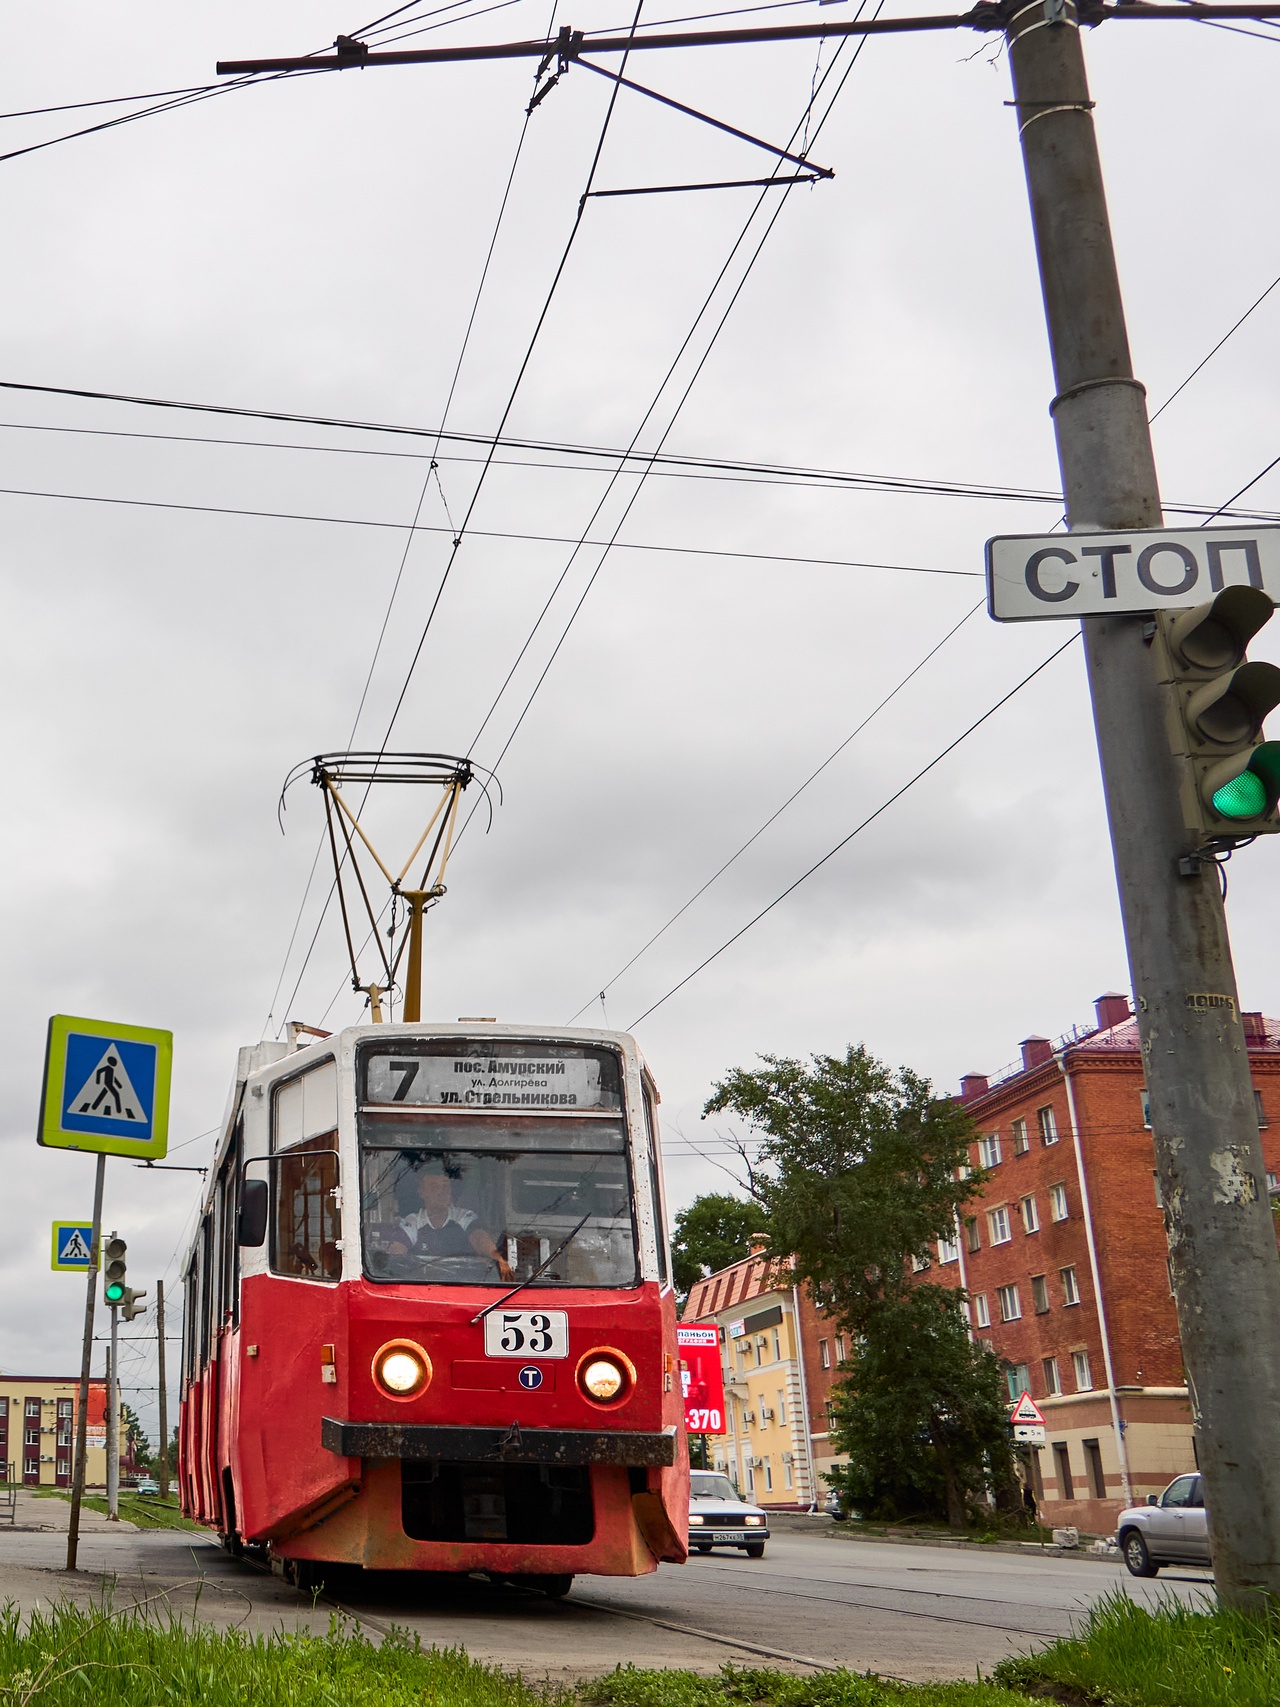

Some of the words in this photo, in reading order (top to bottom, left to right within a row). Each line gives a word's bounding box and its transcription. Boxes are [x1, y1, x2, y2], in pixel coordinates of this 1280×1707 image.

[1025, 540, 1264, 602] СТОП
[453, 1062, 485, 1075] пос.
[488, 1060, 565, 1075] Амурский
[389, 1061, 419, 1102] 7
[471, 1079, 485, 1088] ул.
[440, 1092, 462, 1105] ул.
[465, 1090, 577, 1105] Стрельникова
[501, 1314, 553, 1352] 53
